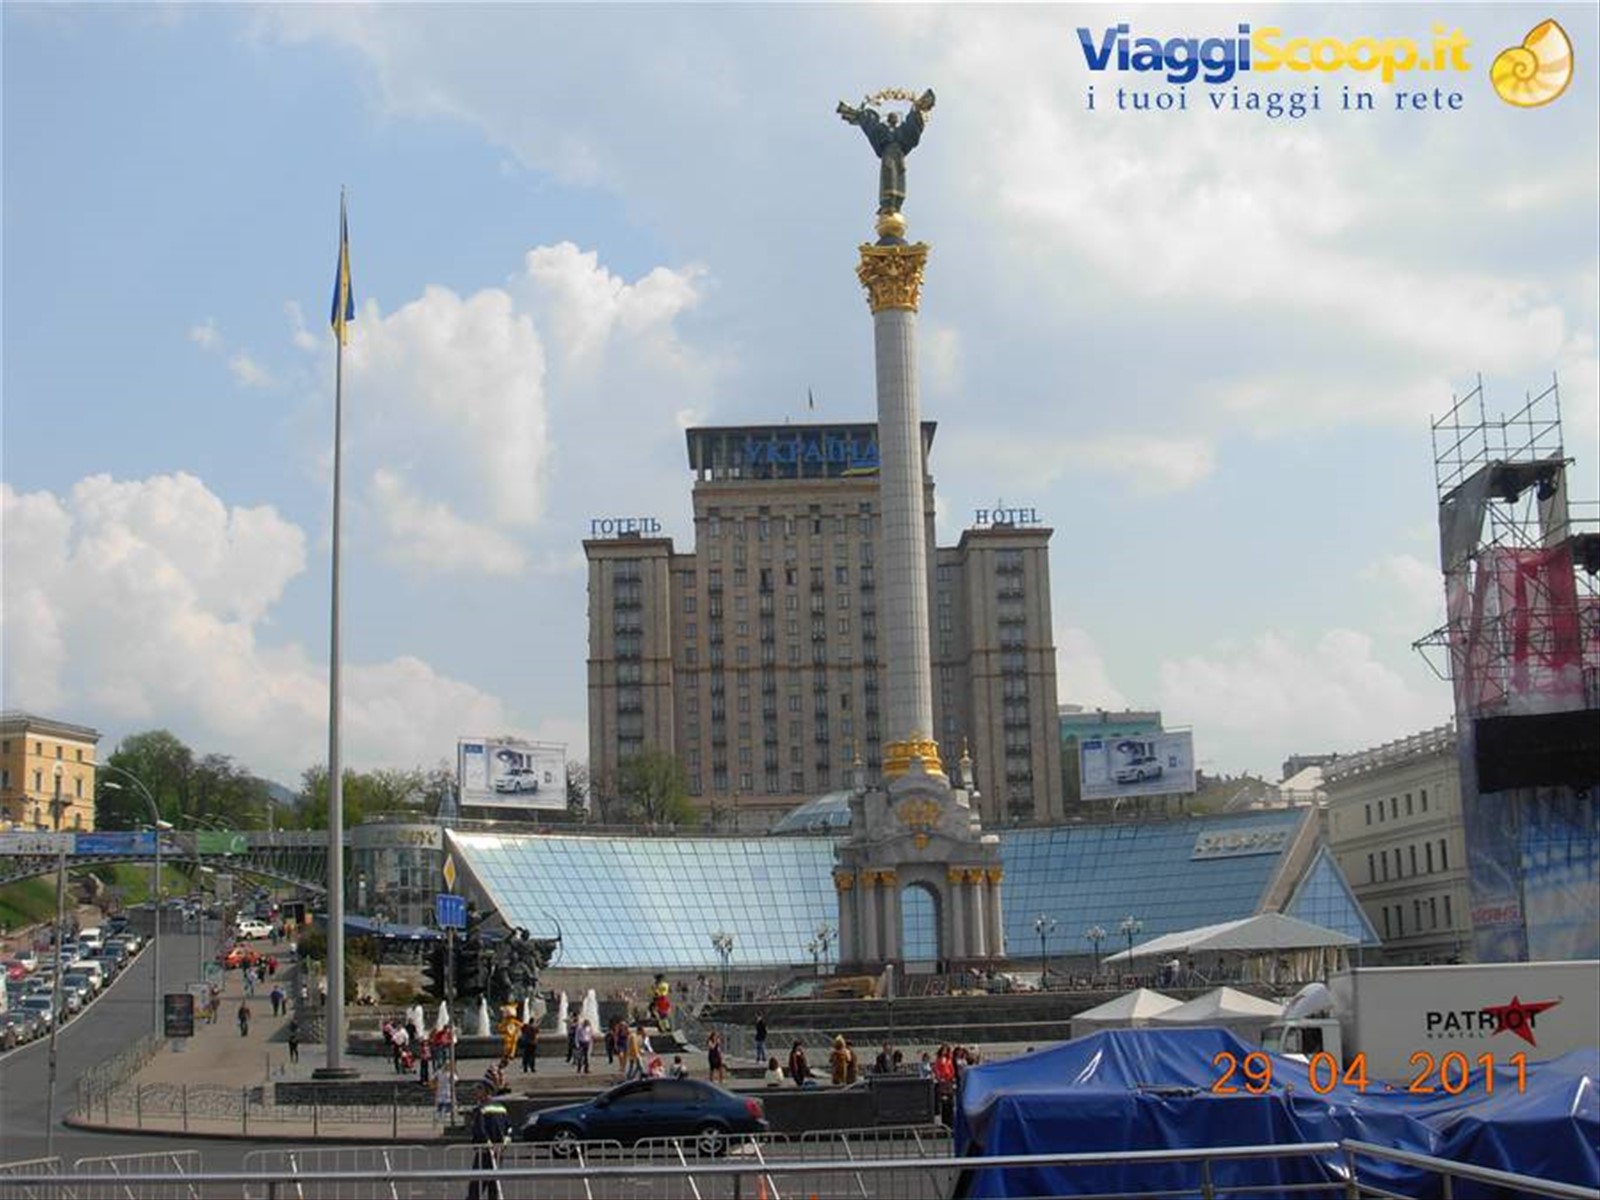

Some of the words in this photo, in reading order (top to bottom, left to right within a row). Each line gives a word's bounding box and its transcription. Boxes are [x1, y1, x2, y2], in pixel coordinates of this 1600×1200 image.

[975, 508, 1041, 524] HOTEL
[591, 518, 661, 535] ГОТЕЛЬ
[1426, 1009, 1537, 1031] PATRIOT
